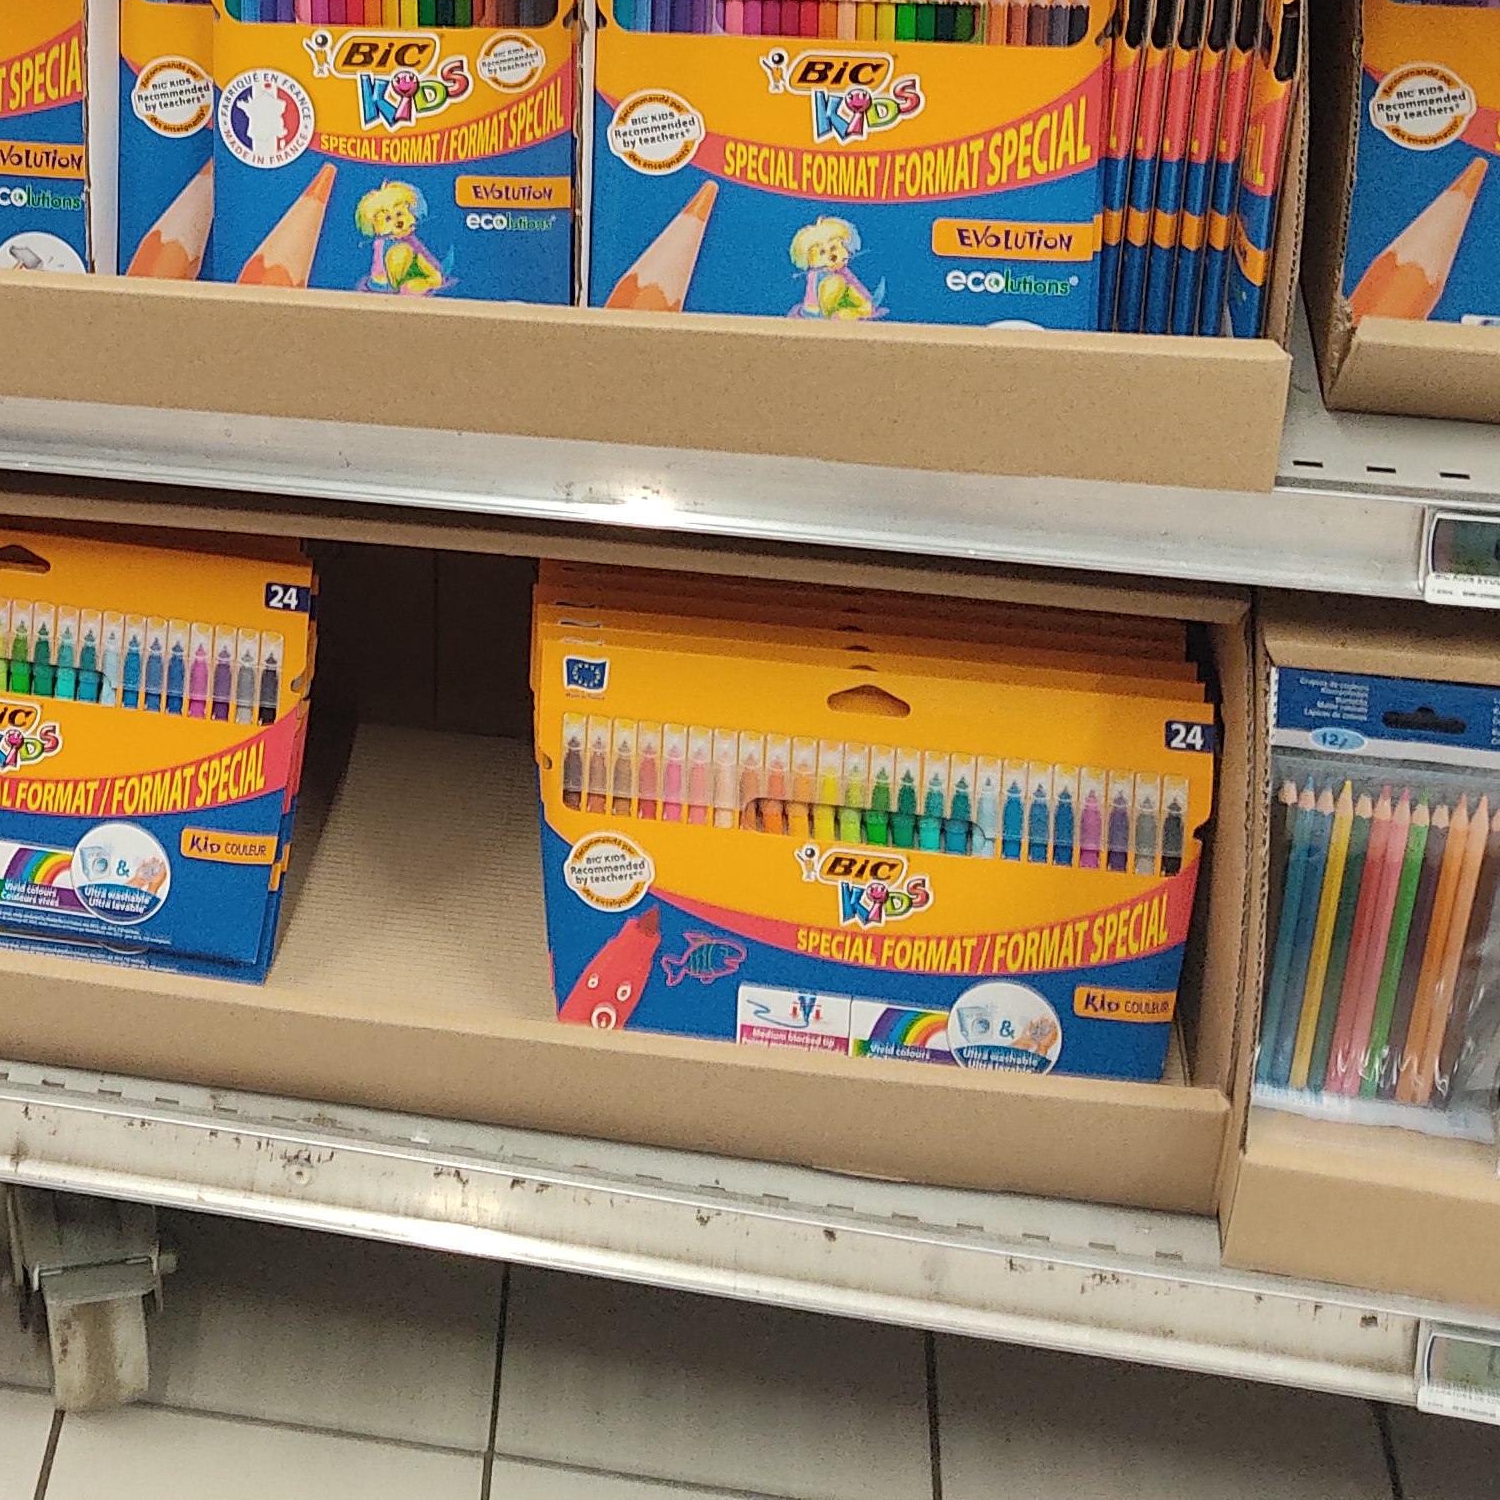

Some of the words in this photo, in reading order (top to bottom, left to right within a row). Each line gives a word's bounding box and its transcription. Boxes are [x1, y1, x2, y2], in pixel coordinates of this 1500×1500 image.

[9, 37, 83, 110] SPECIA
[137, 83, 210, 103] Recommended
[263, 73, 278, 82] EN
[281, 78, 311, 121] FRANCE
[1377, 91, 1466, 111] Recommended
[145, 102, 156, 112] by
[321, 135, 379, 161] SPECIAL
[382, 134, 440, 163] FORMAT
[450, 111, 507, 161] FORMAT
[508, 77, 564, 149] SPECIAL
[631, 116, 649, 126] BIC
[1386, 112, 1400, 123] by
[615, 117, 695, 139] Recommended
[224, 129, 249, 160] MADE
[252, 154, 264, 165] IN
[269, 133, 308, 165] FRANCE
[623, 139, 636, 150] by
[724, 140, 798, 190] SPECIAL
[802, 153, 879, 197] FORMAT
[895, 139, 985, 197] FORMAT
[987, 94, 1091, 186] SPECIAL
[946, 268, 1070, 296] ecolutions
[270, 586, 298, 609] 24
[1171, 724, 1202, 749] 24
[15, 780, 98, 815] FORMAT
[111, 764, 195, 815] FORMAT
[195, 739, 266, 807] SPECIAL
[224, 842, 267, 857] COULEUR
[116, 859, 130, 877] &
[570, 861, 645, 874] Recommended
[586, 856, 601, 864] BIC
[5, 882, 26, 894] Vivid
[27, 883, 57, 897] colours
[575, 876, 587, 886] by
[1, 891, 34, 904] Couleurs
[36, 894, 60, 907] vives
[84, 886, 107, 898] Ultra
[109, 888, 150, 904] washable
[89, 897, 110, 908] Ultra
[112, 898, 145, 913] lavable
[797, 929, 877, 964] SPECIAL
[881, 938, 977, 971] FORMAT
[993, 920, 1089, 973] FORMAT
[1090, 890, 1169, 962] SPECIAL
[1124, 1000, 1170, 1014] COULEUR
[752, 1027, 787, 1041] Medium
[788, 1030, 823, 1045] blocked
[824, 1034, 835, 1047] tip
[1000, 1020, 1014, 1039] &
[870, 1042, 899, 1056] Vivid
[901, 1046, 931, 1060] colours
[963, 1049, 988, 1061] Ultra
